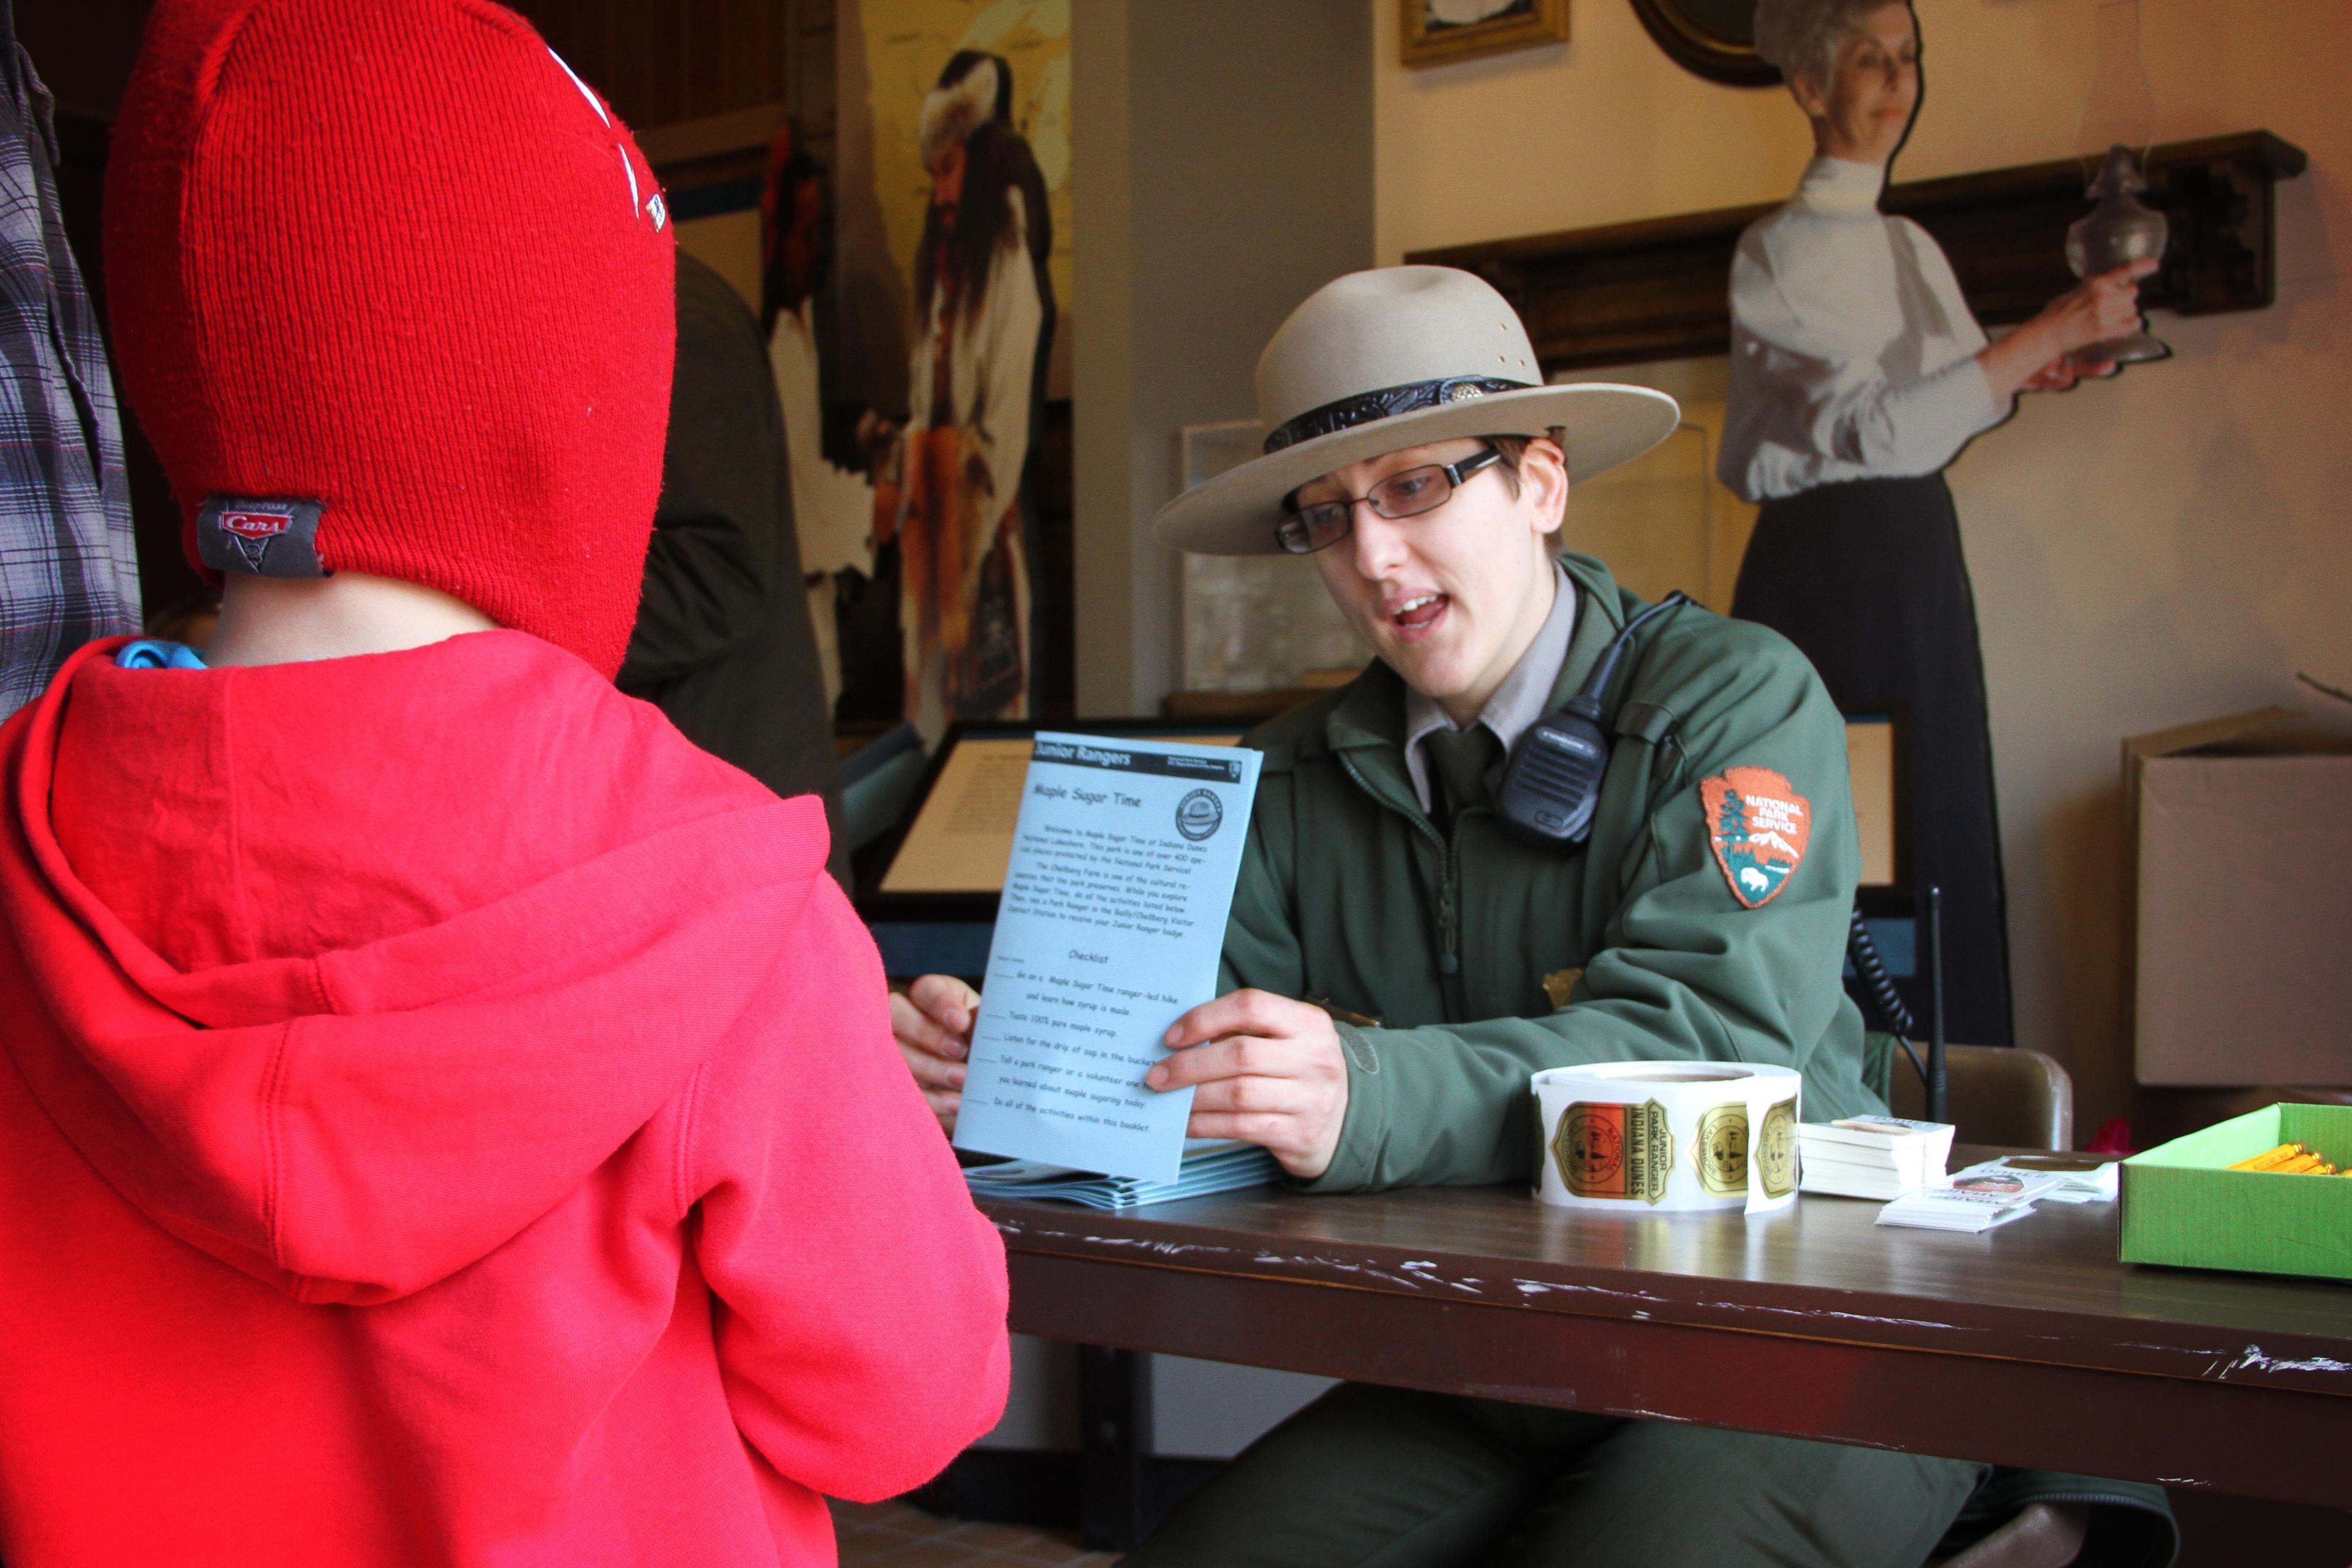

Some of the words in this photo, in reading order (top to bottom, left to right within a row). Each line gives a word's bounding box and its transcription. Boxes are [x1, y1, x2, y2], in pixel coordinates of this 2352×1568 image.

[227, 514, 279, 533] Cars
[1035, 742, 1075, 759] Junior
[1077, 745, 1132, 766] Rangers
[1035, 783, 1067, 799] Maple
[1072, 788, 1108, 805] Sugar
[1114, 791, 1141, 807] Time
[1746, 795, 1803, 816] NATIONAL
[1752, 816, 1797, 834] SERVICE
[1759, 807, 1790, 822] PARK
[1068, 949, 1109, 963] Checklist
[1041, 993, 1059, 1003] learn
[1061, 997, 1075, 1006] how
[1077, 1001, 1098, 1011] syrup
[1048, 975, 1069, 986] Maple
[1072, 979, 1093, 990] Sugar
[1097, 982, 1114, 993] Time
[1117, 988, 1159, 1001] ranger-led
[1161, 994, 1178, 1004] hike
[1009, 1010, 1028, 1021] Taste
[1050, 1019, 1067, 1028] pure
[1069, 1023, 1091, 1032] maple
[1003, 1033, 1023, 1043] Listen
[1026, 1036, 1037, 1046] for
[1039, 1039, 1051, 1049] the
[1053, 1042, 1069, 1053] drip
[1084, 1049, 1098, 1058] sap
[1110, 1053, 1124, 1061] the
[1000, 1054, 1012, 1064] Tell
[1037, 1063, 1062, 1074] ranger
[1086, 1072, 1123, 1084] volunteer
[1125, 1080, 1140, 1090] one
[1012, 1077, 1037, 1089] learned
[1038, 1083, 1061, 1093] about
[1064, 1088, 1087, 1098] maple
[1090, 1093, 1121, 1106] sugaring
[993, 1096, 1002, 1106] Do
[1005, 1099, 1013, 1107] all
[1025, 1103, 1036, 1112] the
[1039, 1107, 1074, 1119] activities
[1077, 1115, 1099, 1123] within
[1102, 1117, 1117, 1126] this
[1651, 1110, 1659, 1140] PARK
[1630, 1107, 1645, 1153] INDIANA
[1607, 1126, 1623, 1170] NATIONAL
[1659, 1129, 1667, 1170] JUNIOR
[1701, 1124, 1718, 1176] LAKESHORE
[1630, 1158, 1645, 1195] DUNES
[1651, 1144, 1659, 1191] RANGER
